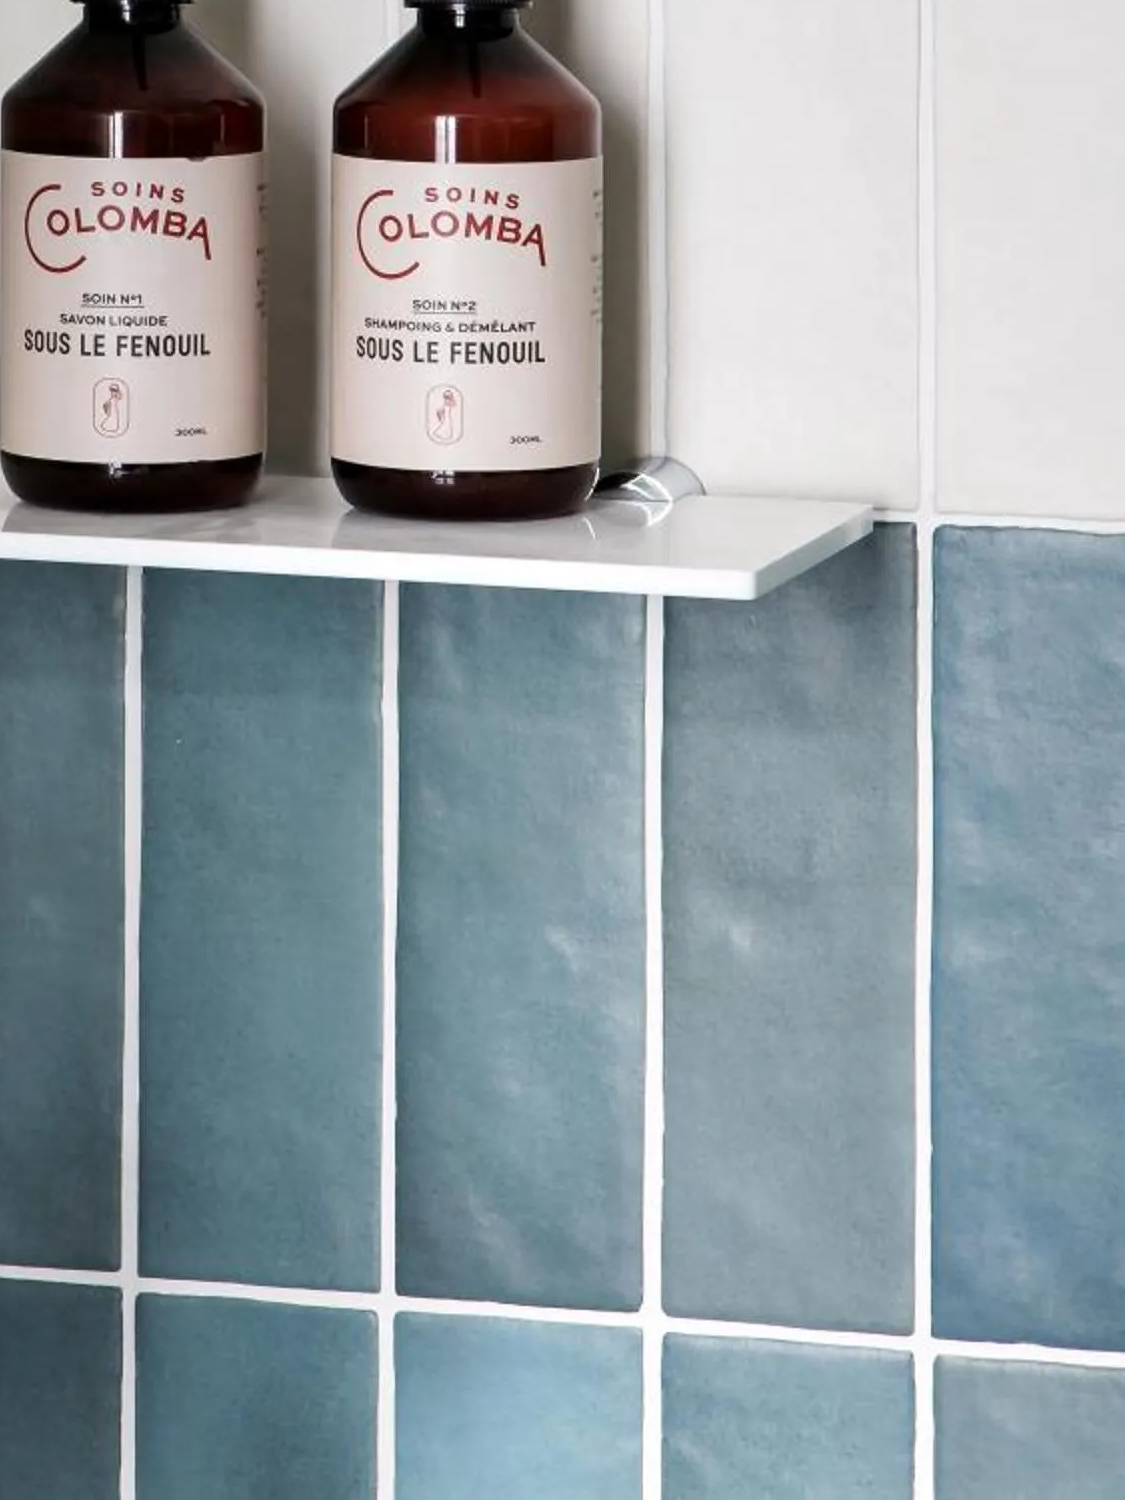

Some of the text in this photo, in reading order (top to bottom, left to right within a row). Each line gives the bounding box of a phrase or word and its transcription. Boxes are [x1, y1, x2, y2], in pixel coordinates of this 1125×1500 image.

[91, 181, 185, 204] SOINS
[425, 186, 520, 209] SOINS
[24, 183, 212, 274] COLOMBA
[357, 190, 546, 279] COLOMBA
[82, 292, 116, 305] SOIN
[412, 299, 448, 311] SOIN
[60, 313, 169, 327] SAVON LIQUIDE
[364, 317, 536, 333] SHAMPOING & DÉMÊLANT
[24, 329, 211, 357] SOUS LE FENOUIL
[356, 335, 546, 365] SOUS LE FENOUIL
